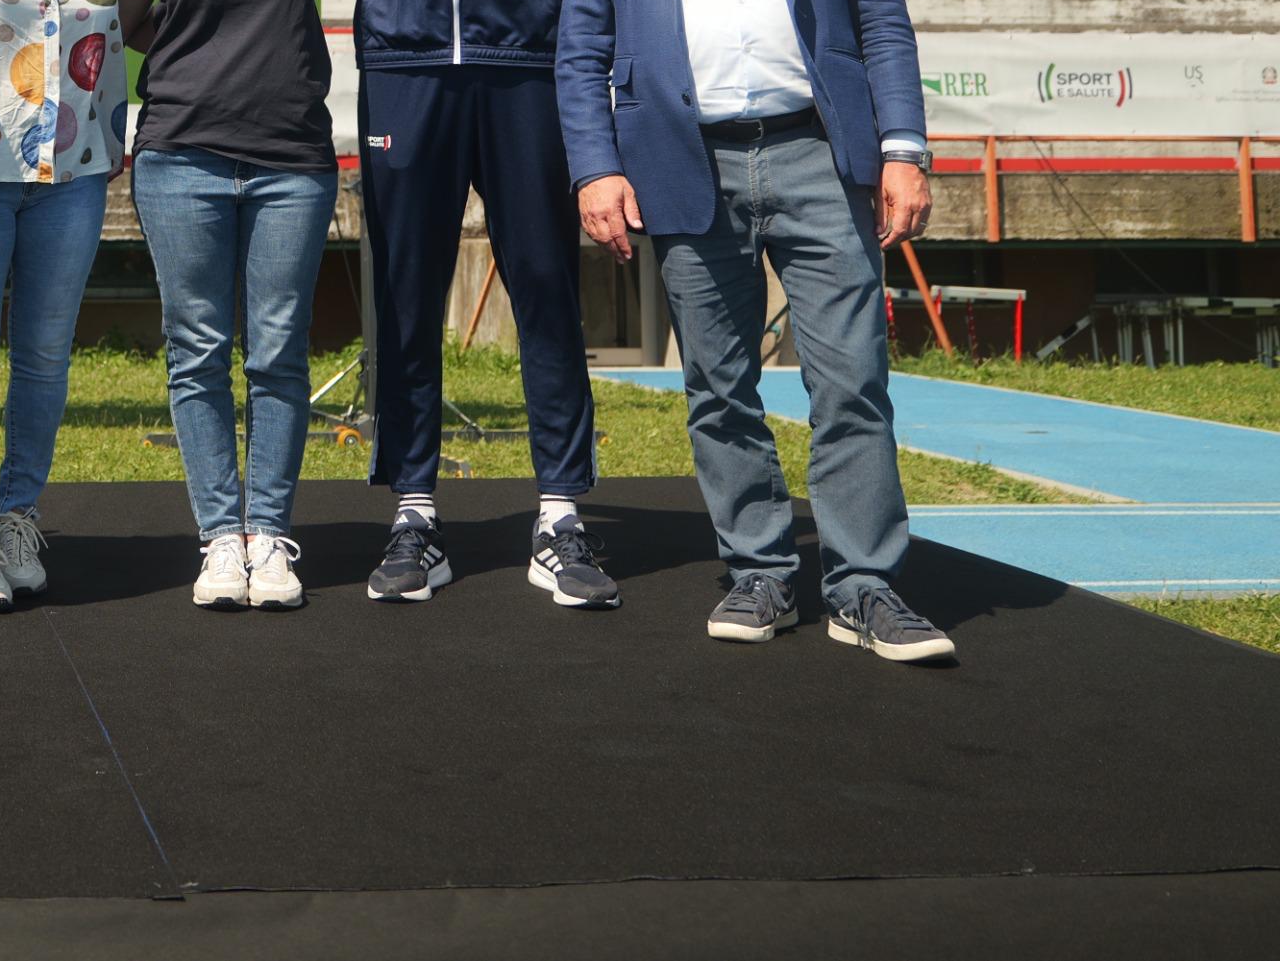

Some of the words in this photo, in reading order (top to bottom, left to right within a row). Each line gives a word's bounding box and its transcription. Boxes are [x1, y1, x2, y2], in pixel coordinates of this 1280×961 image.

[1056, 72, 1114, 86] SPORT
[1057, 88, 1064, 98] E
[1069, 87, 1115, 98] SALUTE
